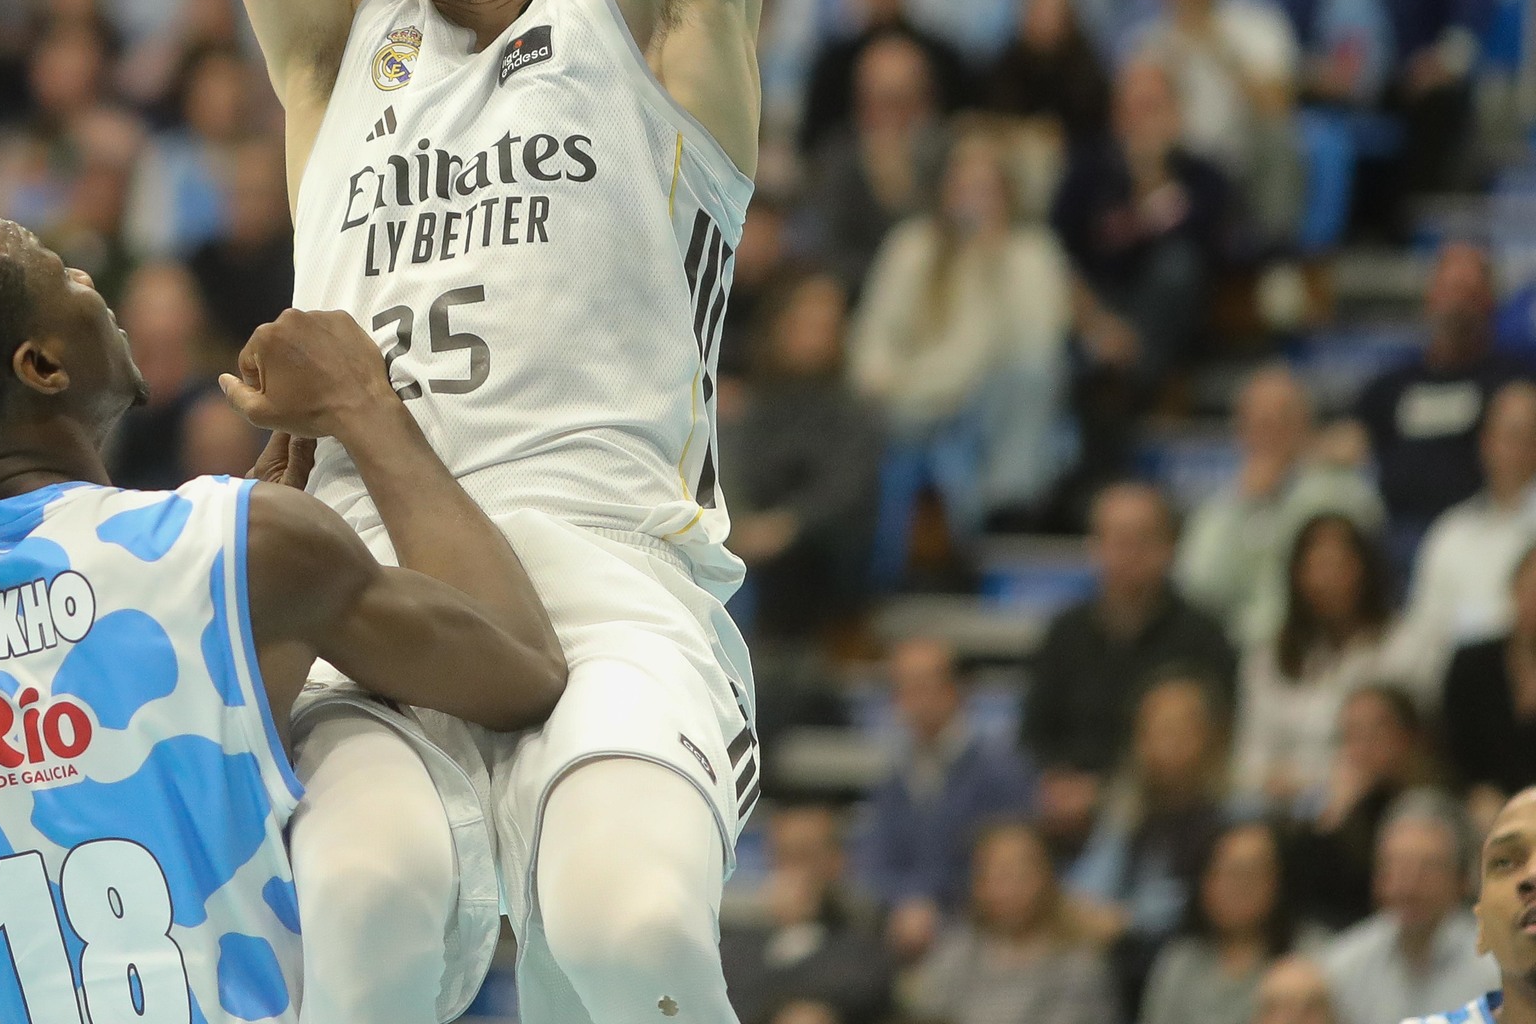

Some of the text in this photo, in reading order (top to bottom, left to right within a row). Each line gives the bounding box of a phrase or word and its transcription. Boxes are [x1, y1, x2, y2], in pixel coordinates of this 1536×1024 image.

[501, 46, 549, 78] endesa
[411, 195, 550, 264] BETTER
[372, 284, 491, 400] 25
[21, 763, 79, 784] GALICIA
